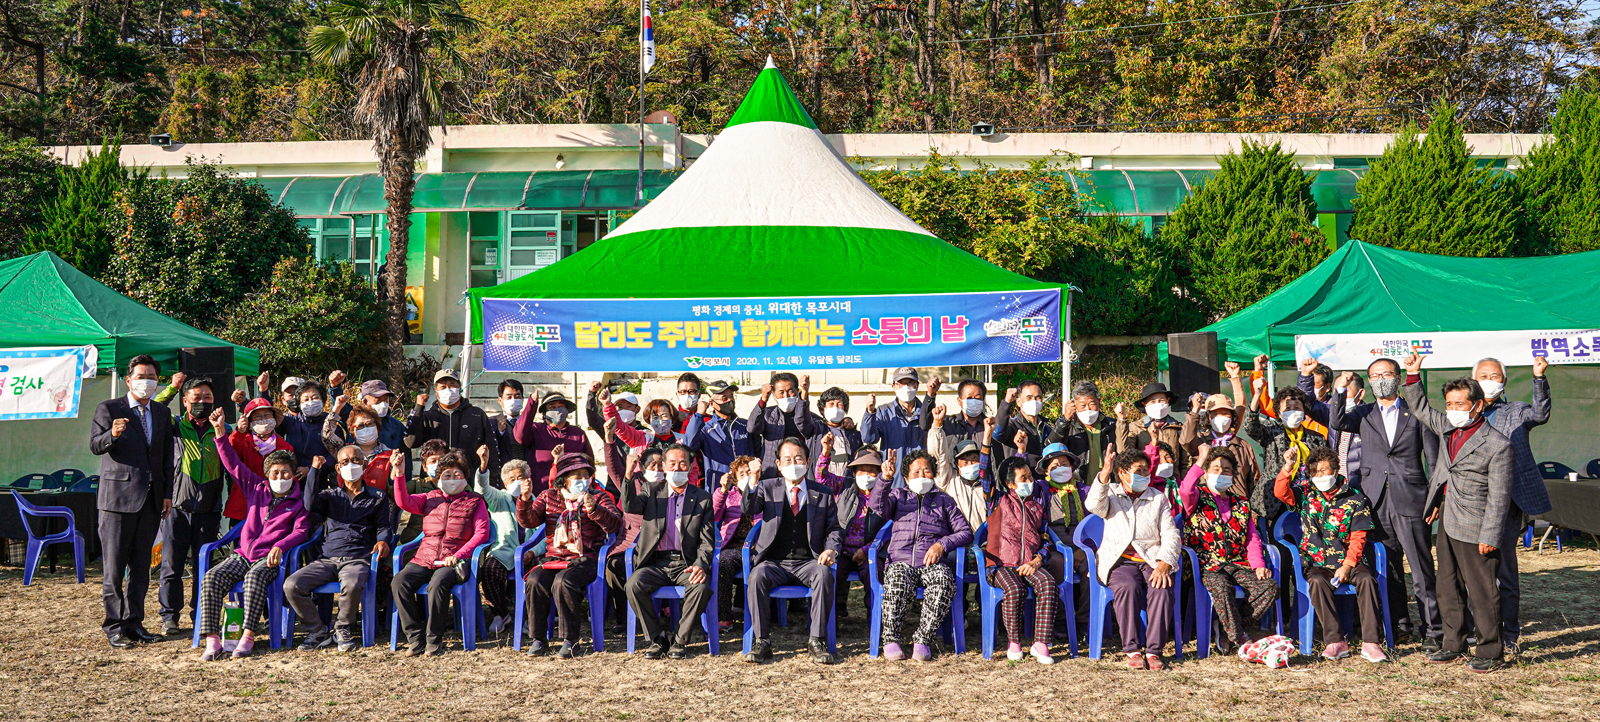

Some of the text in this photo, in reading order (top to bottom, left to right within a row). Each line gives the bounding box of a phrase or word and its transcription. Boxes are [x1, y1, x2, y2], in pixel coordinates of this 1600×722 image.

[692, 300, 851, 316] 평화 경제의 중심, 위대한 목포시대
[506, 325, 534, 333] 대한민국
[574, 315, 969, 349] 달리도 주민과 함께하는 소통의 날
[1020, 318, 1046, 344] 목포
[535, 326, 560, 350] 목포
[1382, 340, 1409, 348] 대한민국
[703, 358, 731, 366] 목포시
[736, 357, 760, 366] 2020.
[762, 357, 774, 366] 11.
[807, 355, 834, 365] 유달동
[836, 355, 862, 364] 달리도
[10, 375, 45, 396] 검사
